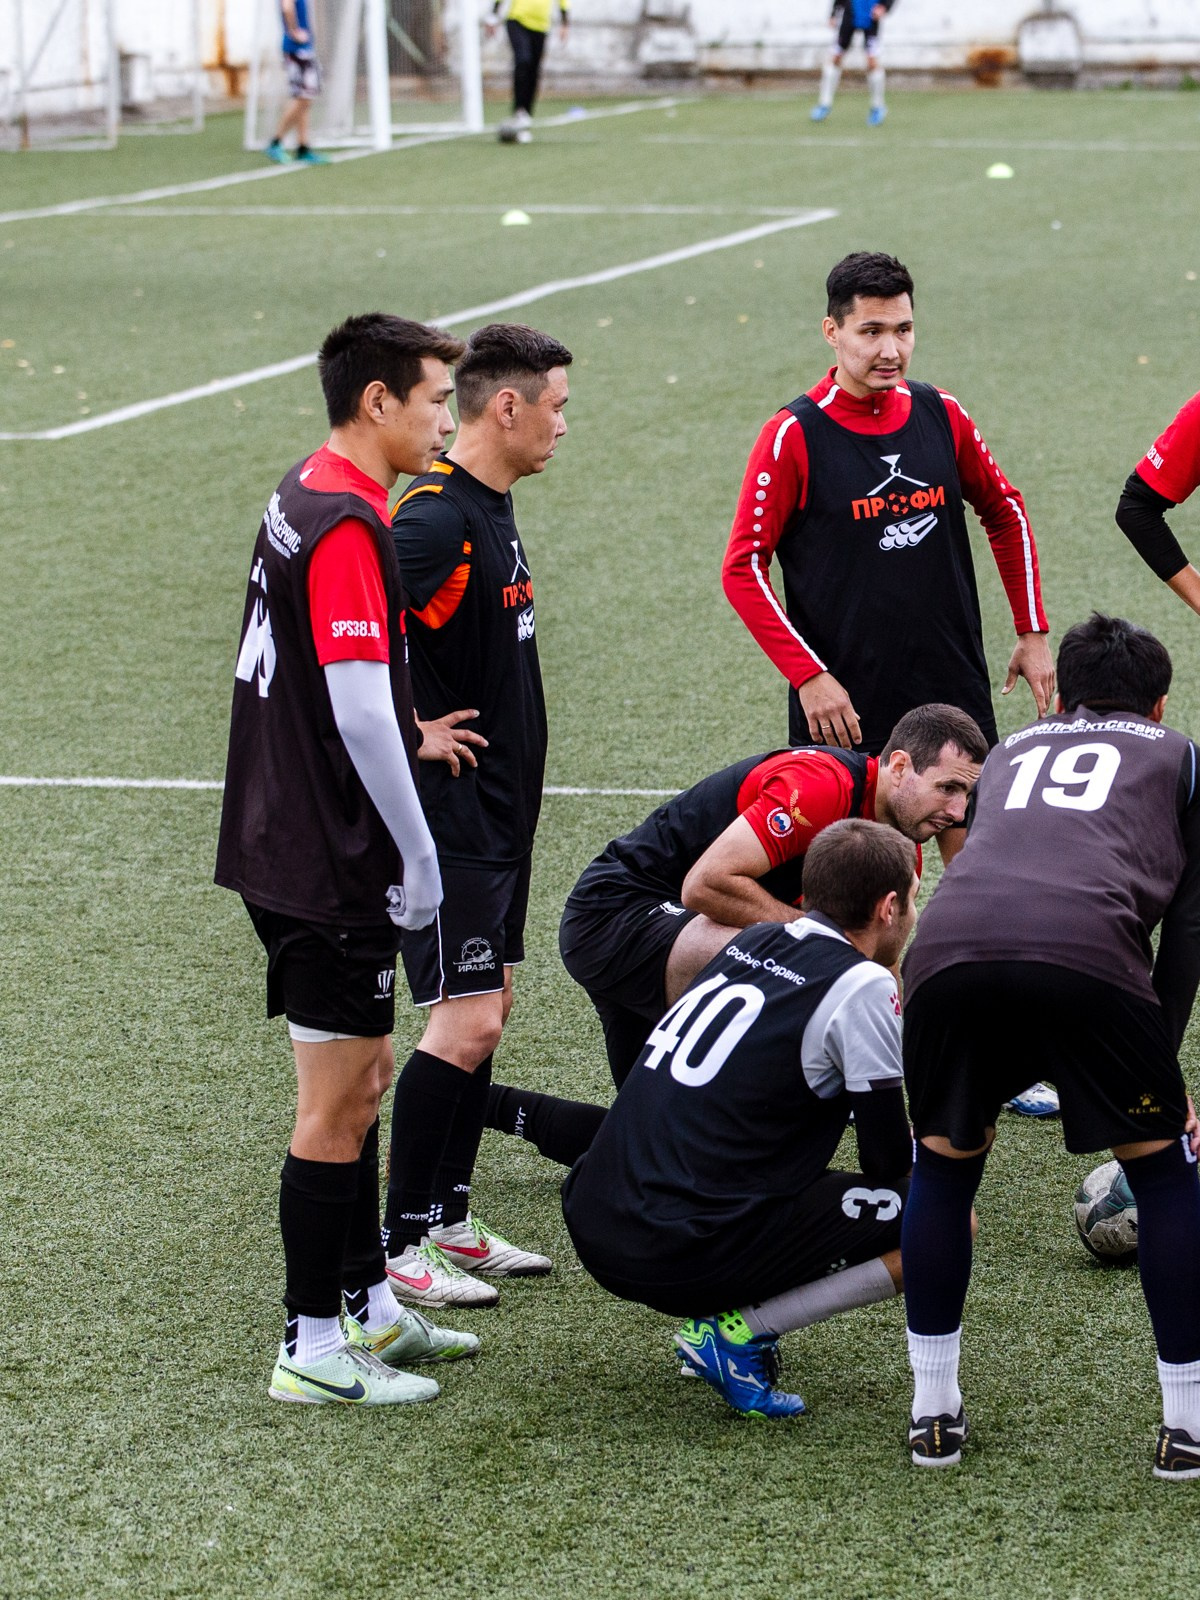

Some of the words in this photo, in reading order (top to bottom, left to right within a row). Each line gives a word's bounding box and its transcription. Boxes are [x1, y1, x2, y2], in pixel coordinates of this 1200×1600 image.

[1004, 742, 1122, 812] 19
[643, 971, 766, 1088] 40
[1128, 1106, 1163, 1115] KELME
